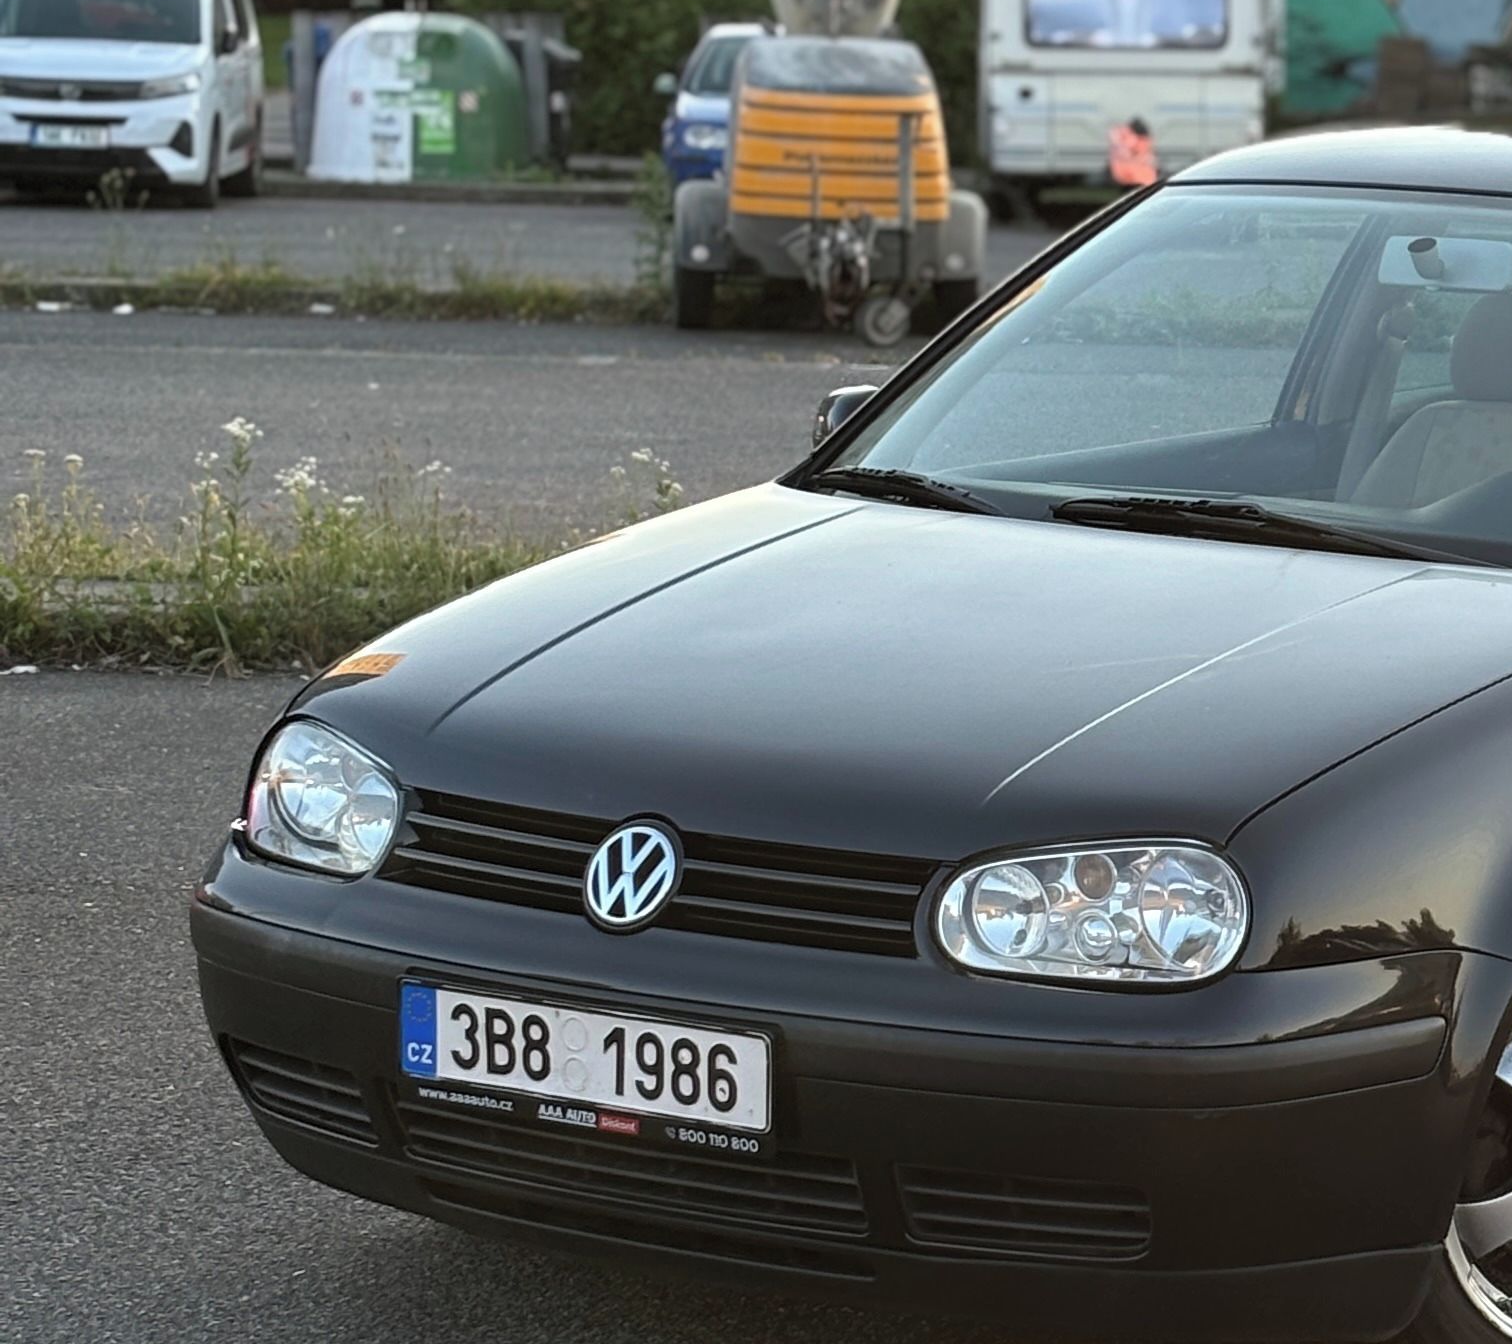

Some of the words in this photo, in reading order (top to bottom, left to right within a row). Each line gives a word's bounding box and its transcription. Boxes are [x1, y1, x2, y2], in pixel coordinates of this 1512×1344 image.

[587, 825, 676, 923] VW
[406, 1041, 434, 1066] CZ
[449, 1002, 551, 1082] 3B8
[602, 1025, 739, 1113] 1986
[537, 1103, 564, 1119] AAA
[566, 1109, 597, 1125] AUTO
[678, 1130, 706, 1145] 800
[708, 1132, 729, 1148] 110
[730, 1136, 759, 1153] 800
